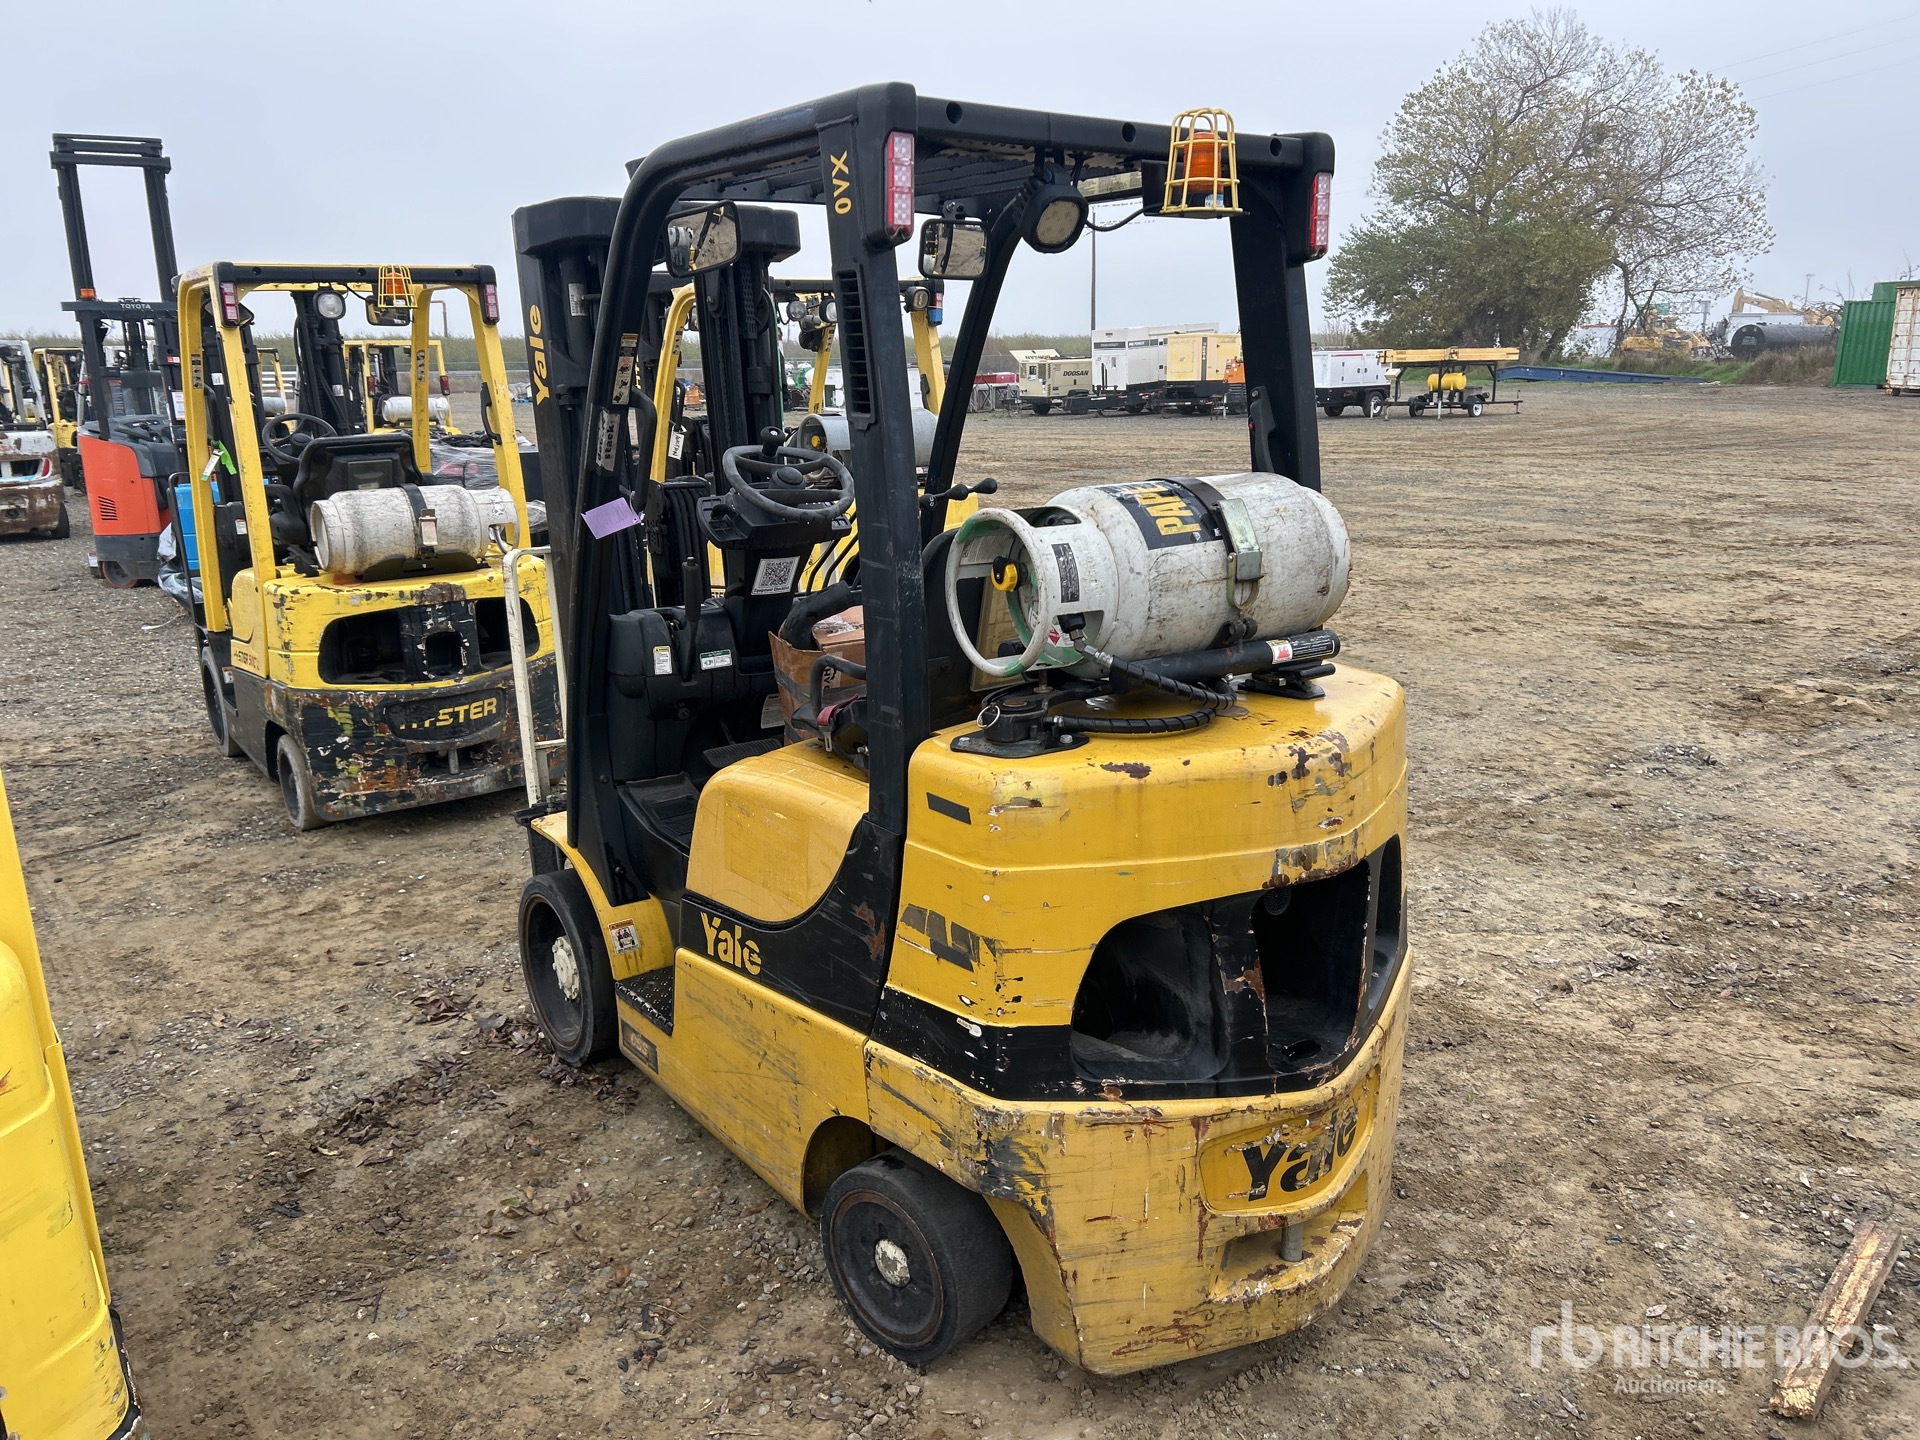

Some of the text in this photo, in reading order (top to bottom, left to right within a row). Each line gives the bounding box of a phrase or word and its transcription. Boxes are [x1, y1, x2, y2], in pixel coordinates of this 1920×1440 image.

[529, 304, 550, 406] Yale
[605, 424, 615, 460] stack
[399, 697, 498, 730] STER
[700, 911, 762, 976] Yale
